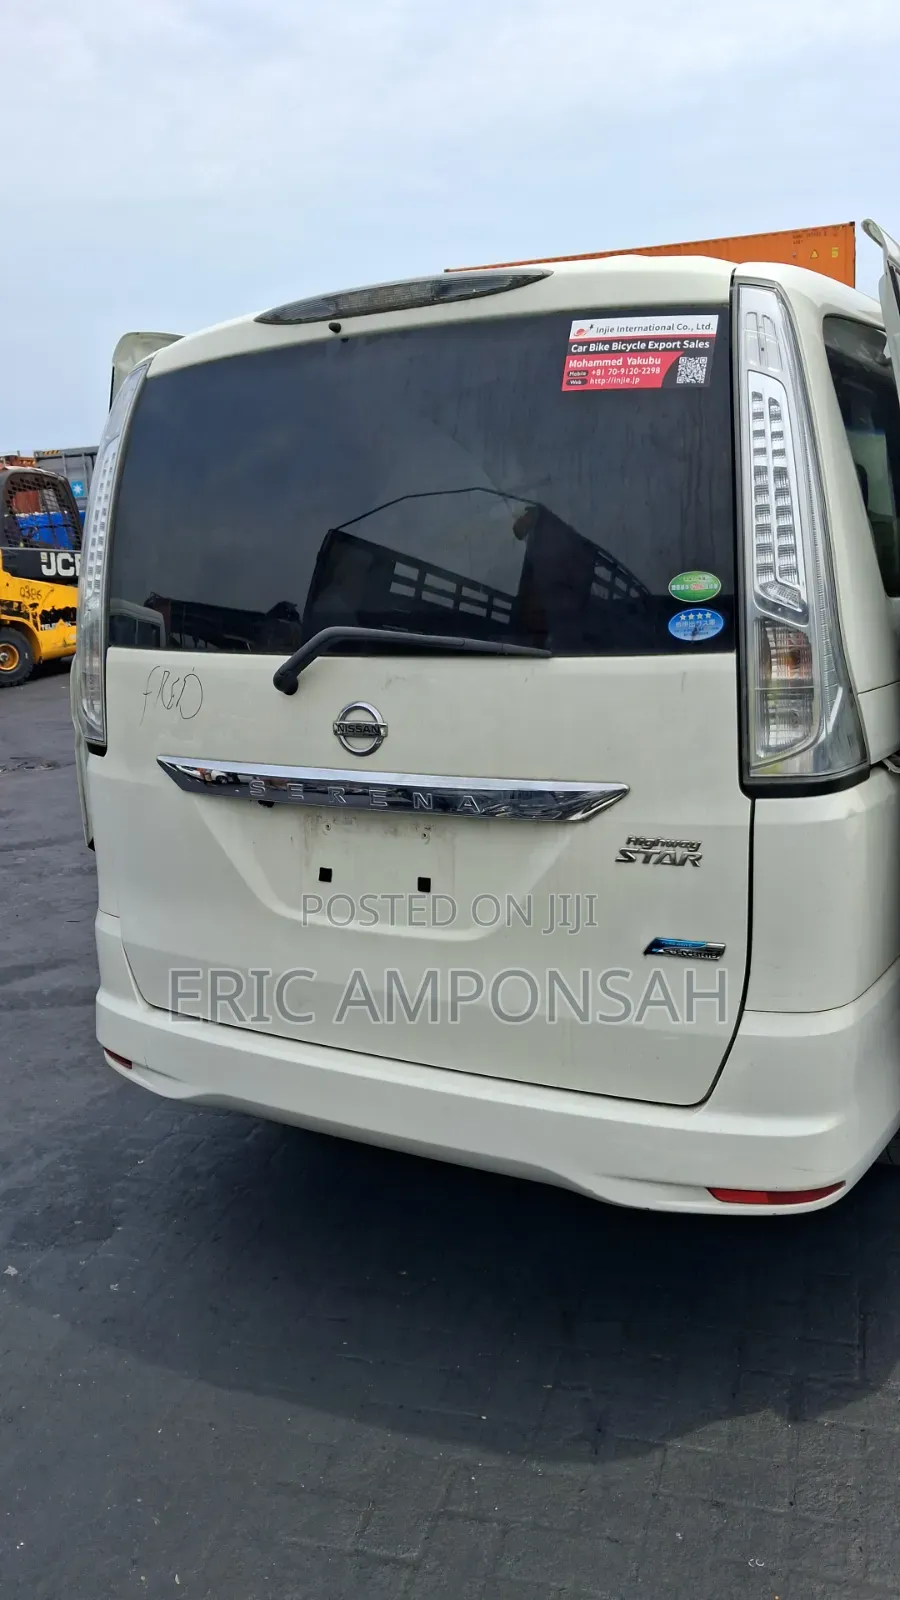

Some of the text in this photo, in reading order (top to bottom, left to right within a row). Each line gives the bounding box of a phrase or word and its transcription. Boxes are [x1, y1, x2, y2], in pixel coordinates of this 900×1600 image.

[596, 322, 714, 335] Injie International Co., Ltd.
[571, 339, 710, 353] Car Bike Bicycle Export Sales
[569, 356, 661, 368] Mohammed Yakubu
[592, 368, 605, 376] +81
[337, 722, 381, 735] NISSAN
[249, 779, 482, 814] SERENA
[626, 836, 703, 852] Highway
[615, 847, 703, 867] STAR
